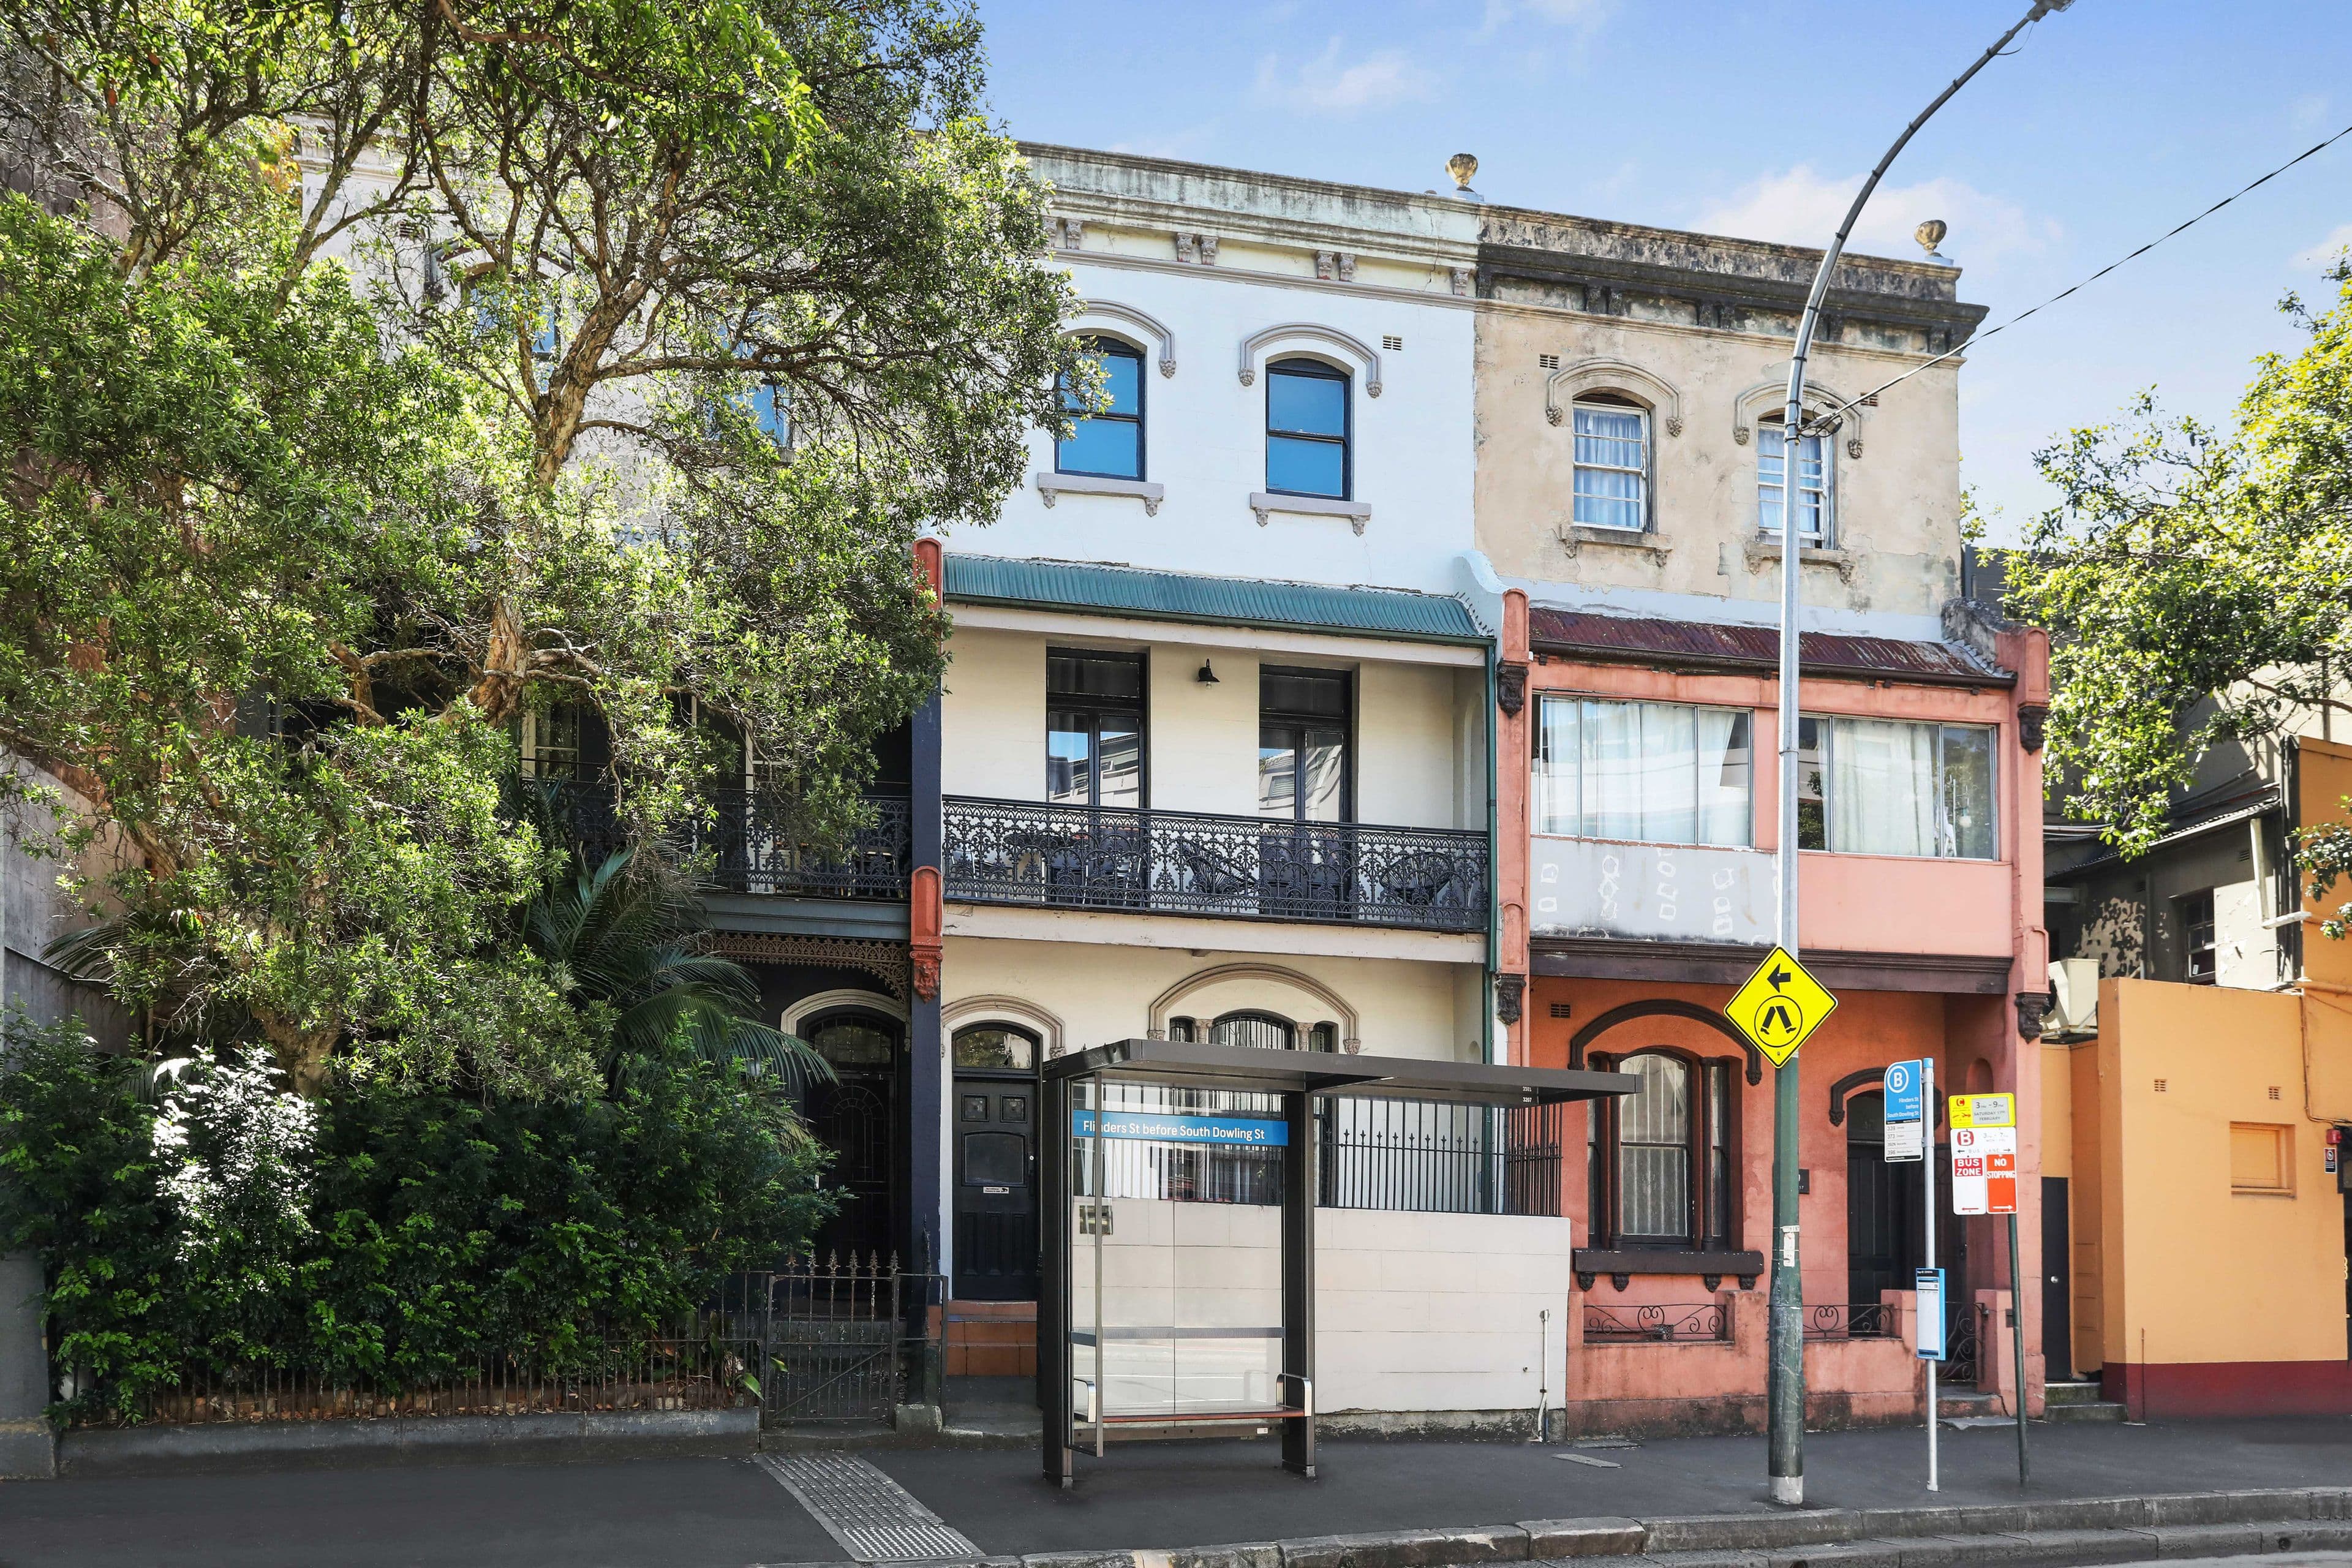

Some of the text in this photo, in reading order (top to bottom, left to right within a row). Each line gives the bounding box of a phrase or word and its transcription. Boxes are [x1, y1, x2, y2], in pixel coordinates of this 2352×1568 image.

[1894, 1072, 1903, 1088] B
[1083, 1120, 1265, 1142] Fliders St before South Dowling St
[1960, 1131, 1972, 1146] B
[1957, 1158, 1980, 1167] BUS
[1994, 1158, 2007, 1167] NO
[1956, 1167, 1981, 1176] ZONE
[1986, 1170, 2015, 1179] STOPPING
